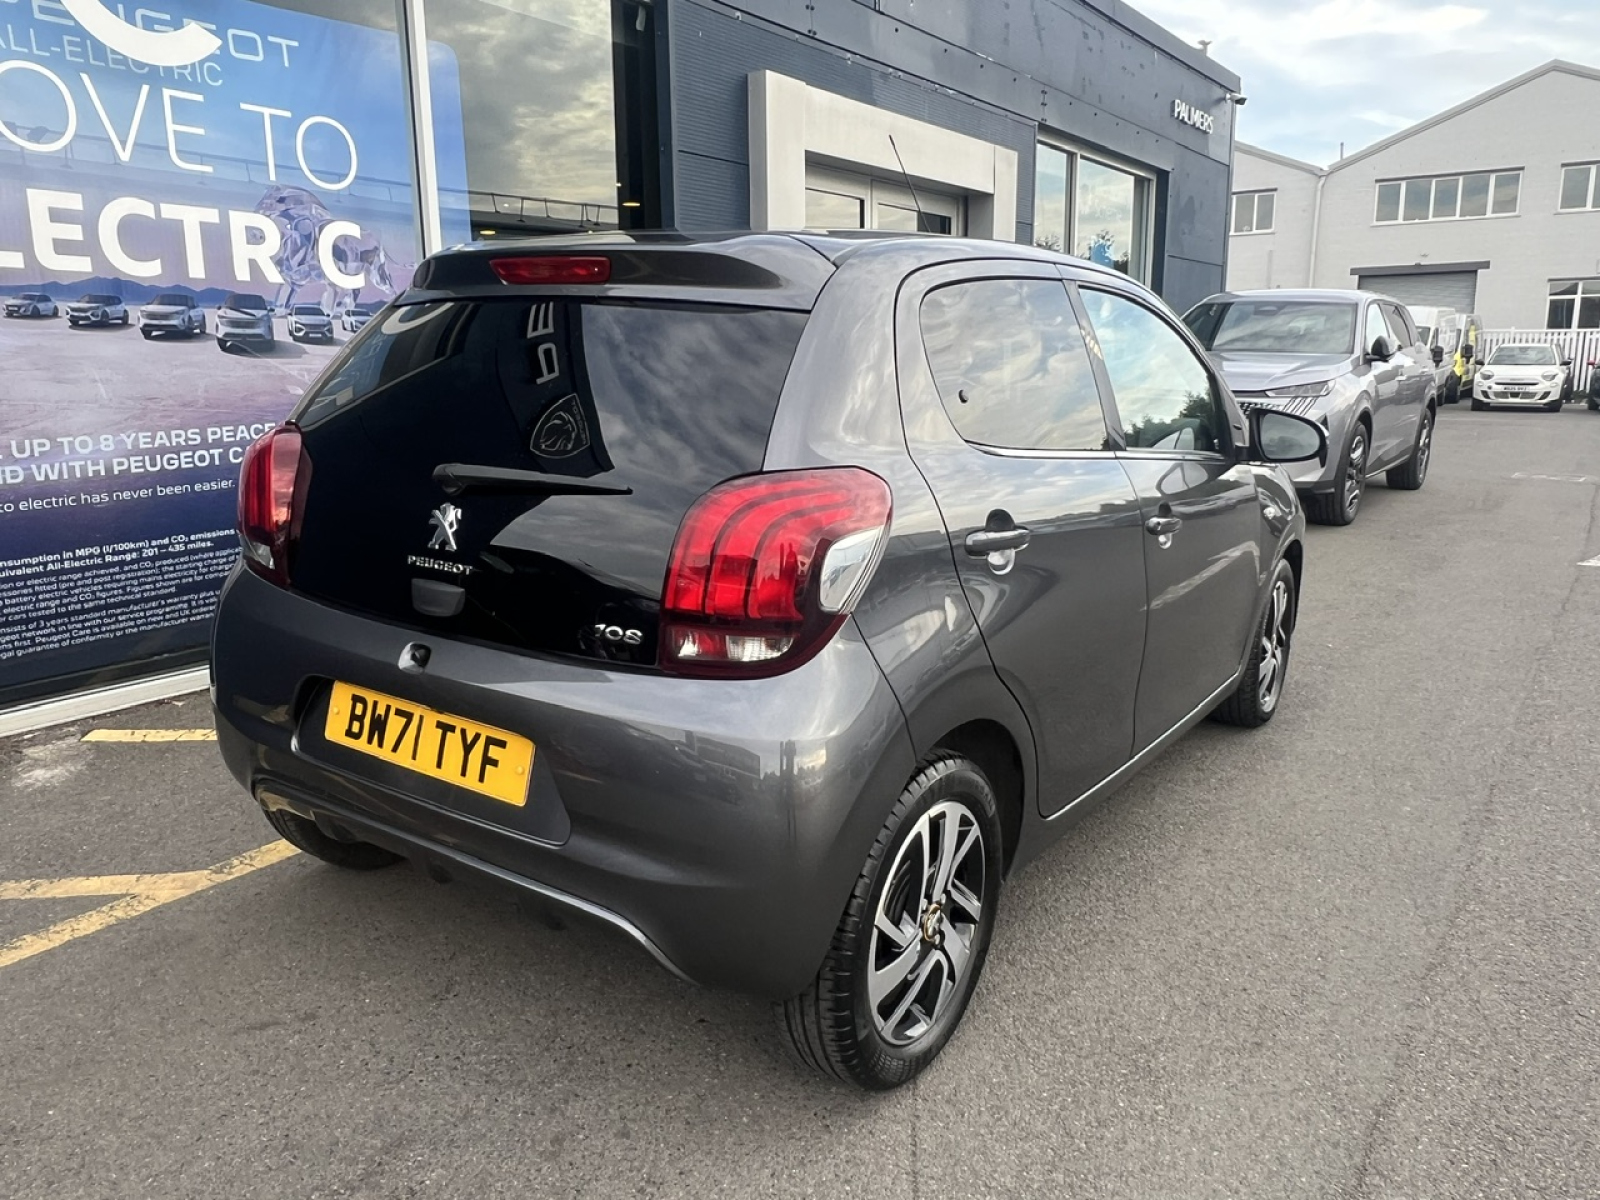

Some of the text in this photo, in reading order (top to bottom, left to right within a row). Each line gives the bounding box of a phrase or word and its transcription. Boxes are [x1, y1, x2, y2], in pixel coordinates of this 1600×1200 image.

[1174, 99, 1215, 134] PALMERS
[240, 102, 358, 190] TO
[10, 438, 51, 458] UP
[57, 434, 94, 455] TO
[100, 434, 115, 451] 8
[120, 428, 201, 450] YEARS
[31, 459, 106, 482] WITH
[113, 449, 223, 475] PEUGEOT
[19, 494, 77, 512] electric
[80, 490, 109, 505] has
[113, 486, 153, 501] never
[157, 483, 191, 497] been
[194, 478, 236, 493] easier.
[46, 556, 104, 571] All-Electric
[142, 547, 159, 558] 201
[168, 543, 186, 552] 435
[63, 550, 74, 559] in
[151, 537, 170, 547] and
[190, 528, 235, 541] emissions
[26, 576, 57, 586] electric
[123, 563, 139, 571] and
[407, 554, 473, 575] PEUGEOT
[344, 693, 508, 784] BW71 TYF
